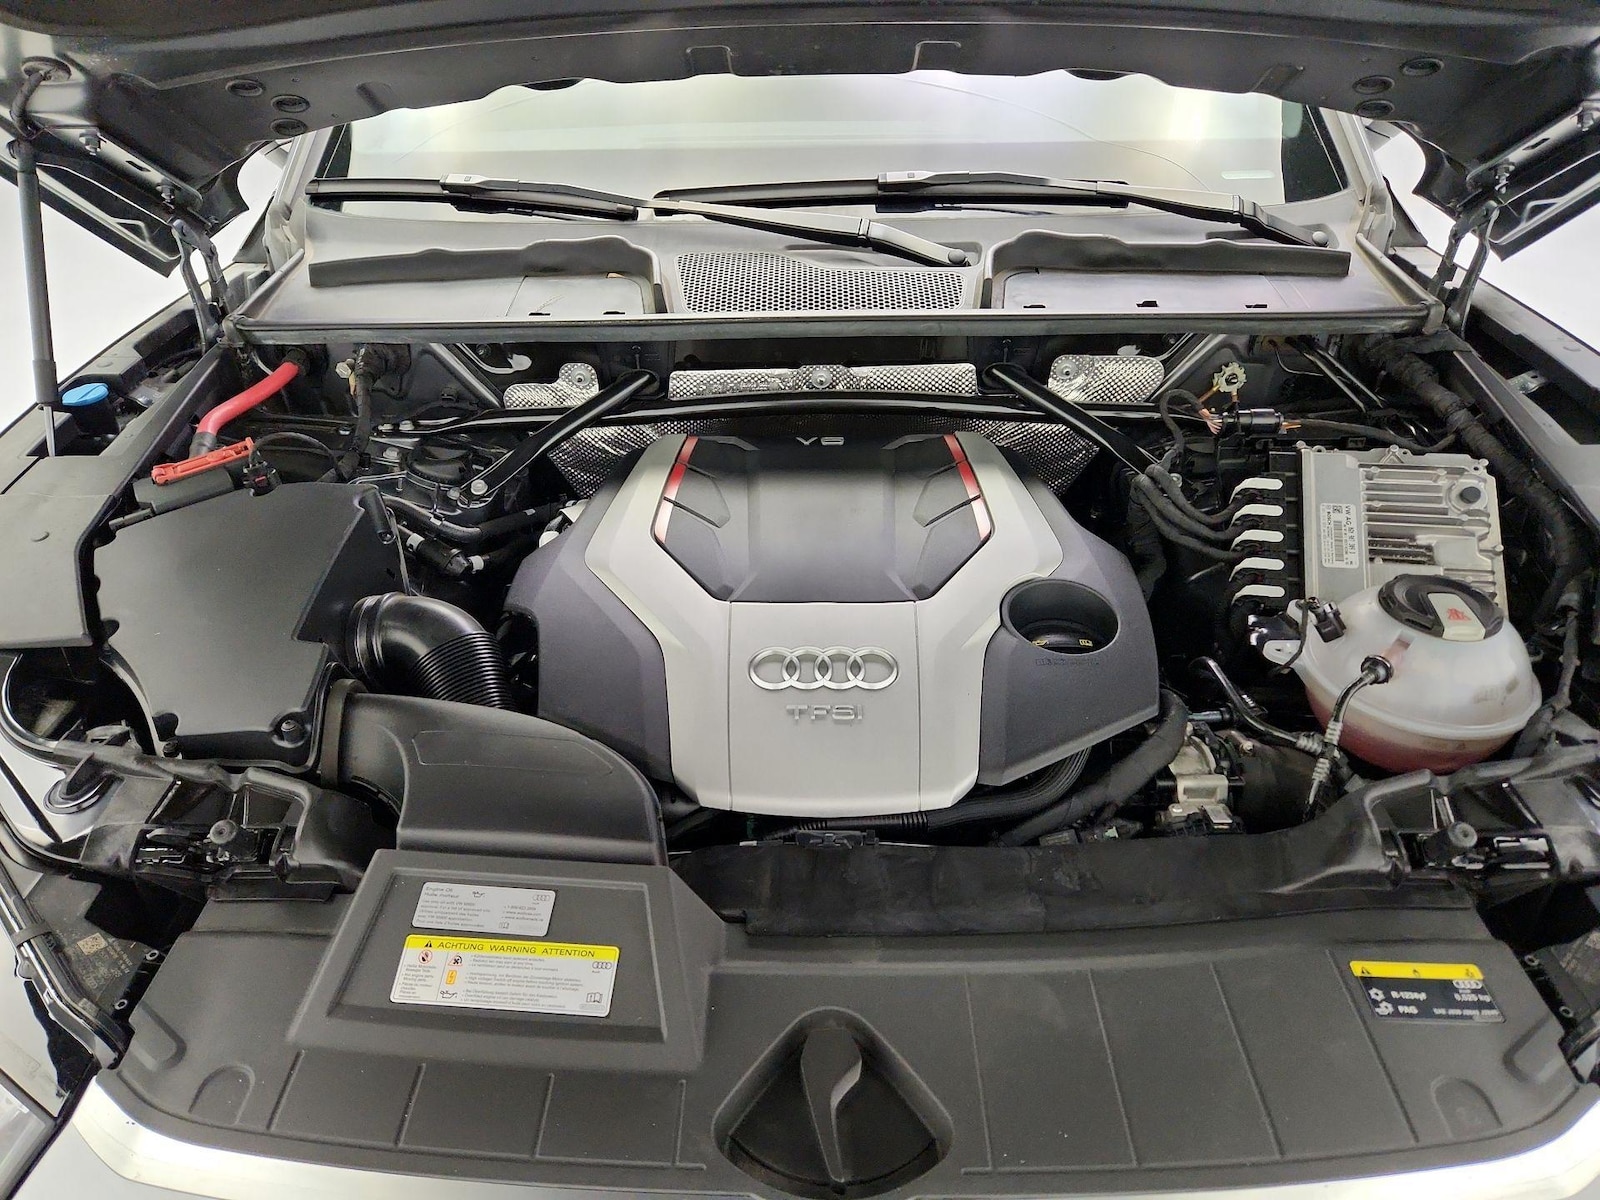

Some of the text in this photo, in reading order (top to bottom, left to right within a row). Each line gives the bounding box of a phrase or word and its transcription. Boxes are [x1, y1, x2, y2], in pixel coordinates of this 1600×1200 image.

[785, 704, 864, 720] TFSI
[437, 941, 596, 958] ACHTUNG WARNING ATTENTION
